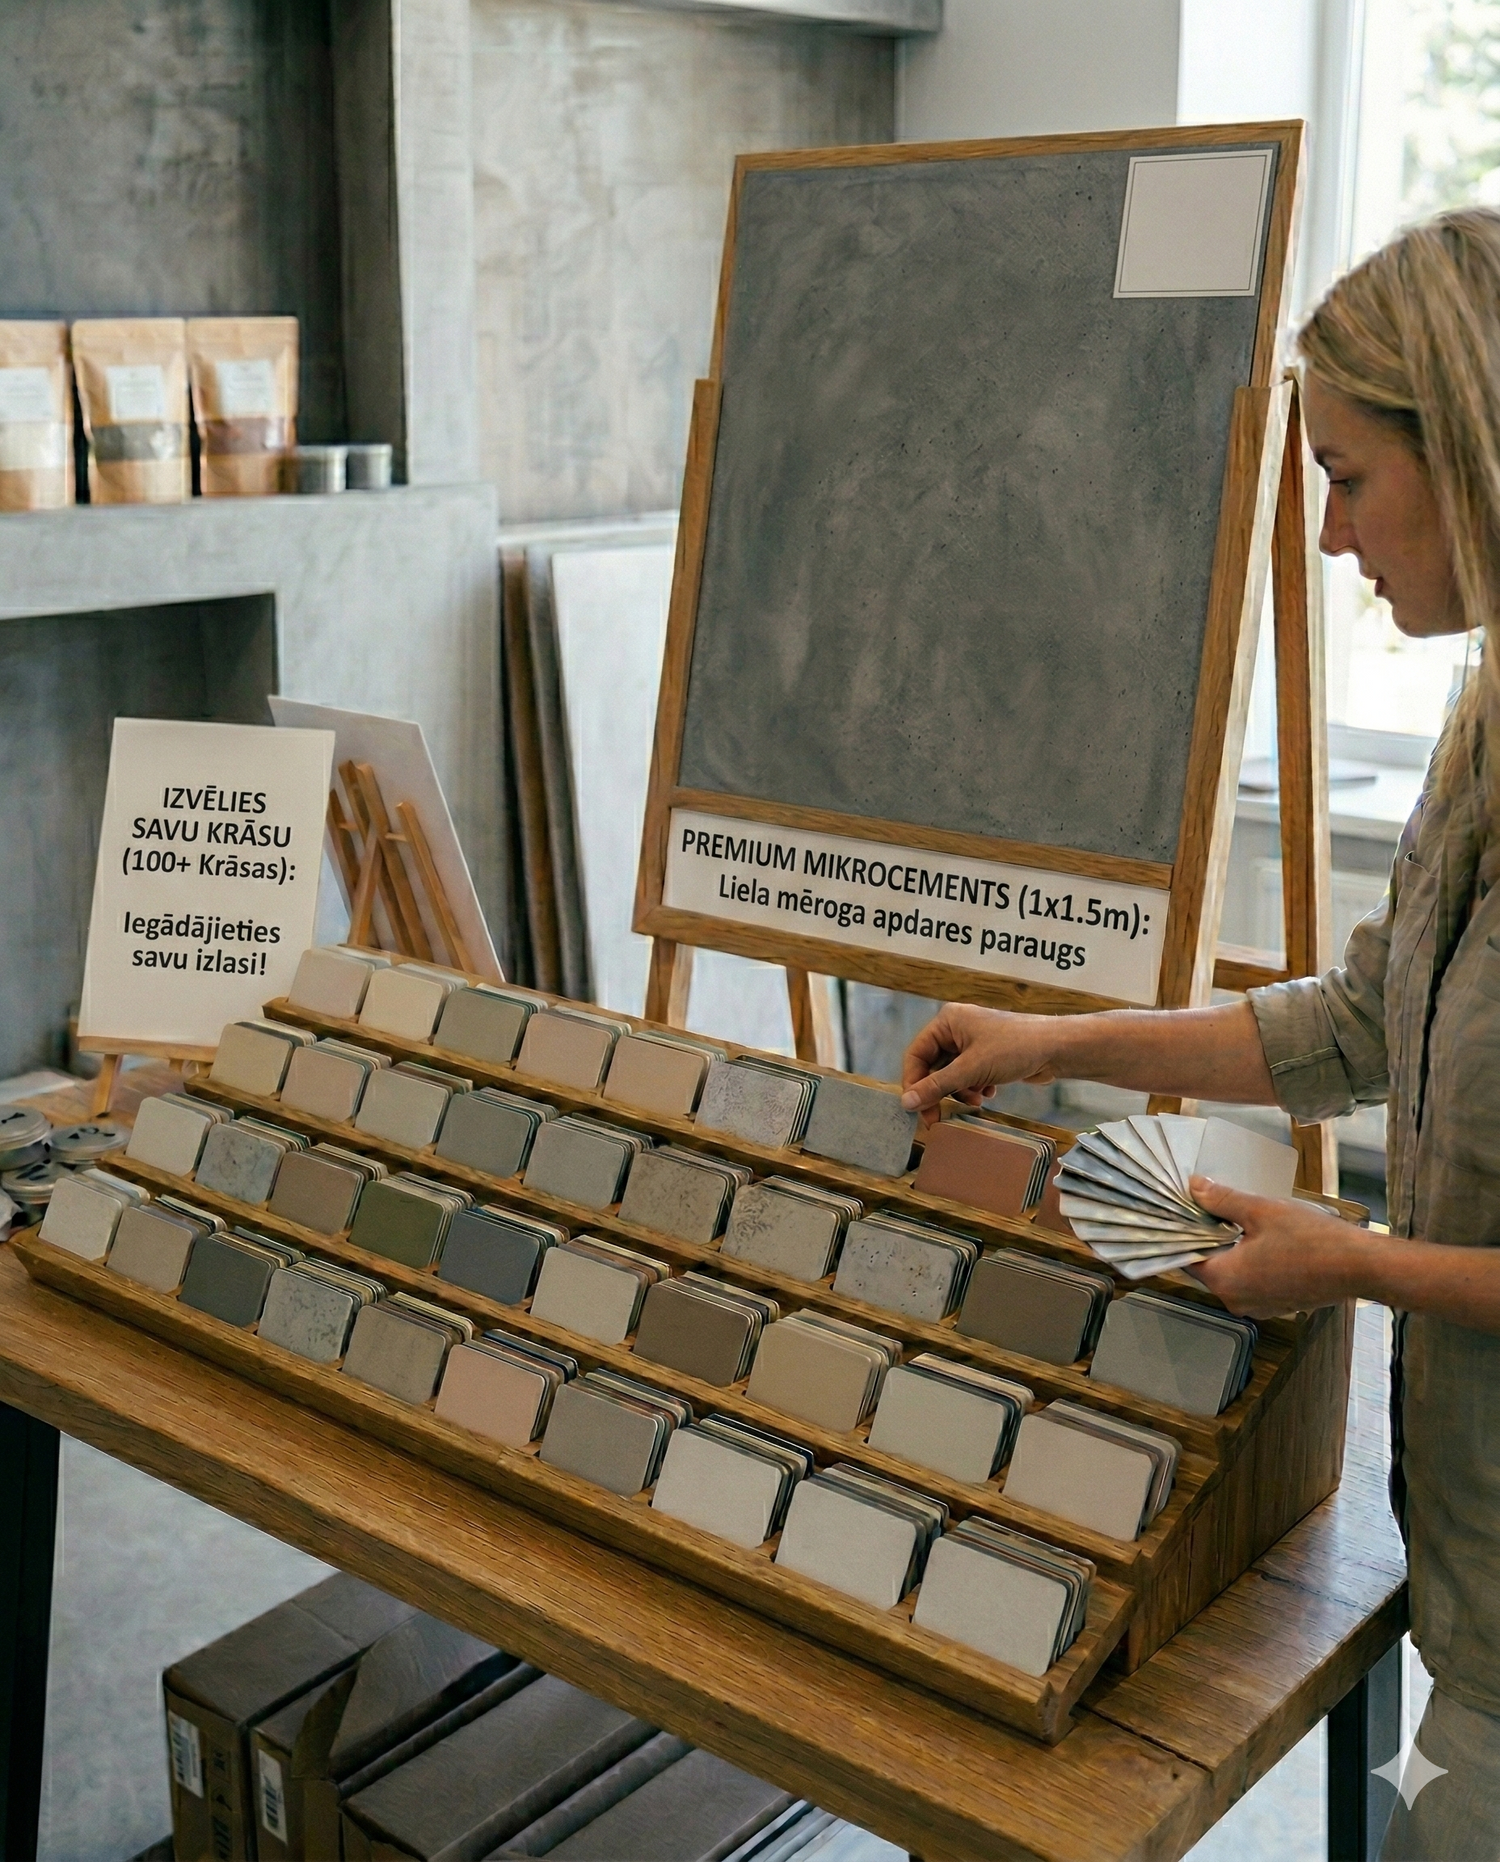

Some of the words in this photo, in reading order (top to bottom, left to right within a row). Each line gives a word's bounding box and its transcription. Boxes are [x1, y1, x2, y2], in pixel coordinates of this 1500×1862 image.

[163, 785, 266, 813] IZVĒLIES
[132, 817, 198, 841] SAVU
[207, 819, 291, 848] KRĀSU
[122, 848, 191, 875] (100+
[199, 854, 295, 885] Krāsas):
[682, 829, 795, 872] PREMIUM
[804, 849, 1010, 910] MIKROCEMENTS
[1019, 885, 1150, 939] (1x1.5m):
[124, 912, 280, 944] Iegādājieties
[720, 874, 770, 906] Liela
[778, 889, 865, 927] mēroga
[873, 910, 972, 945] apdares
[981, 927, 1086, 970] paraugs
[132, 950, 187, 970] savu
[196, 949, 266, 975] izlasi!
